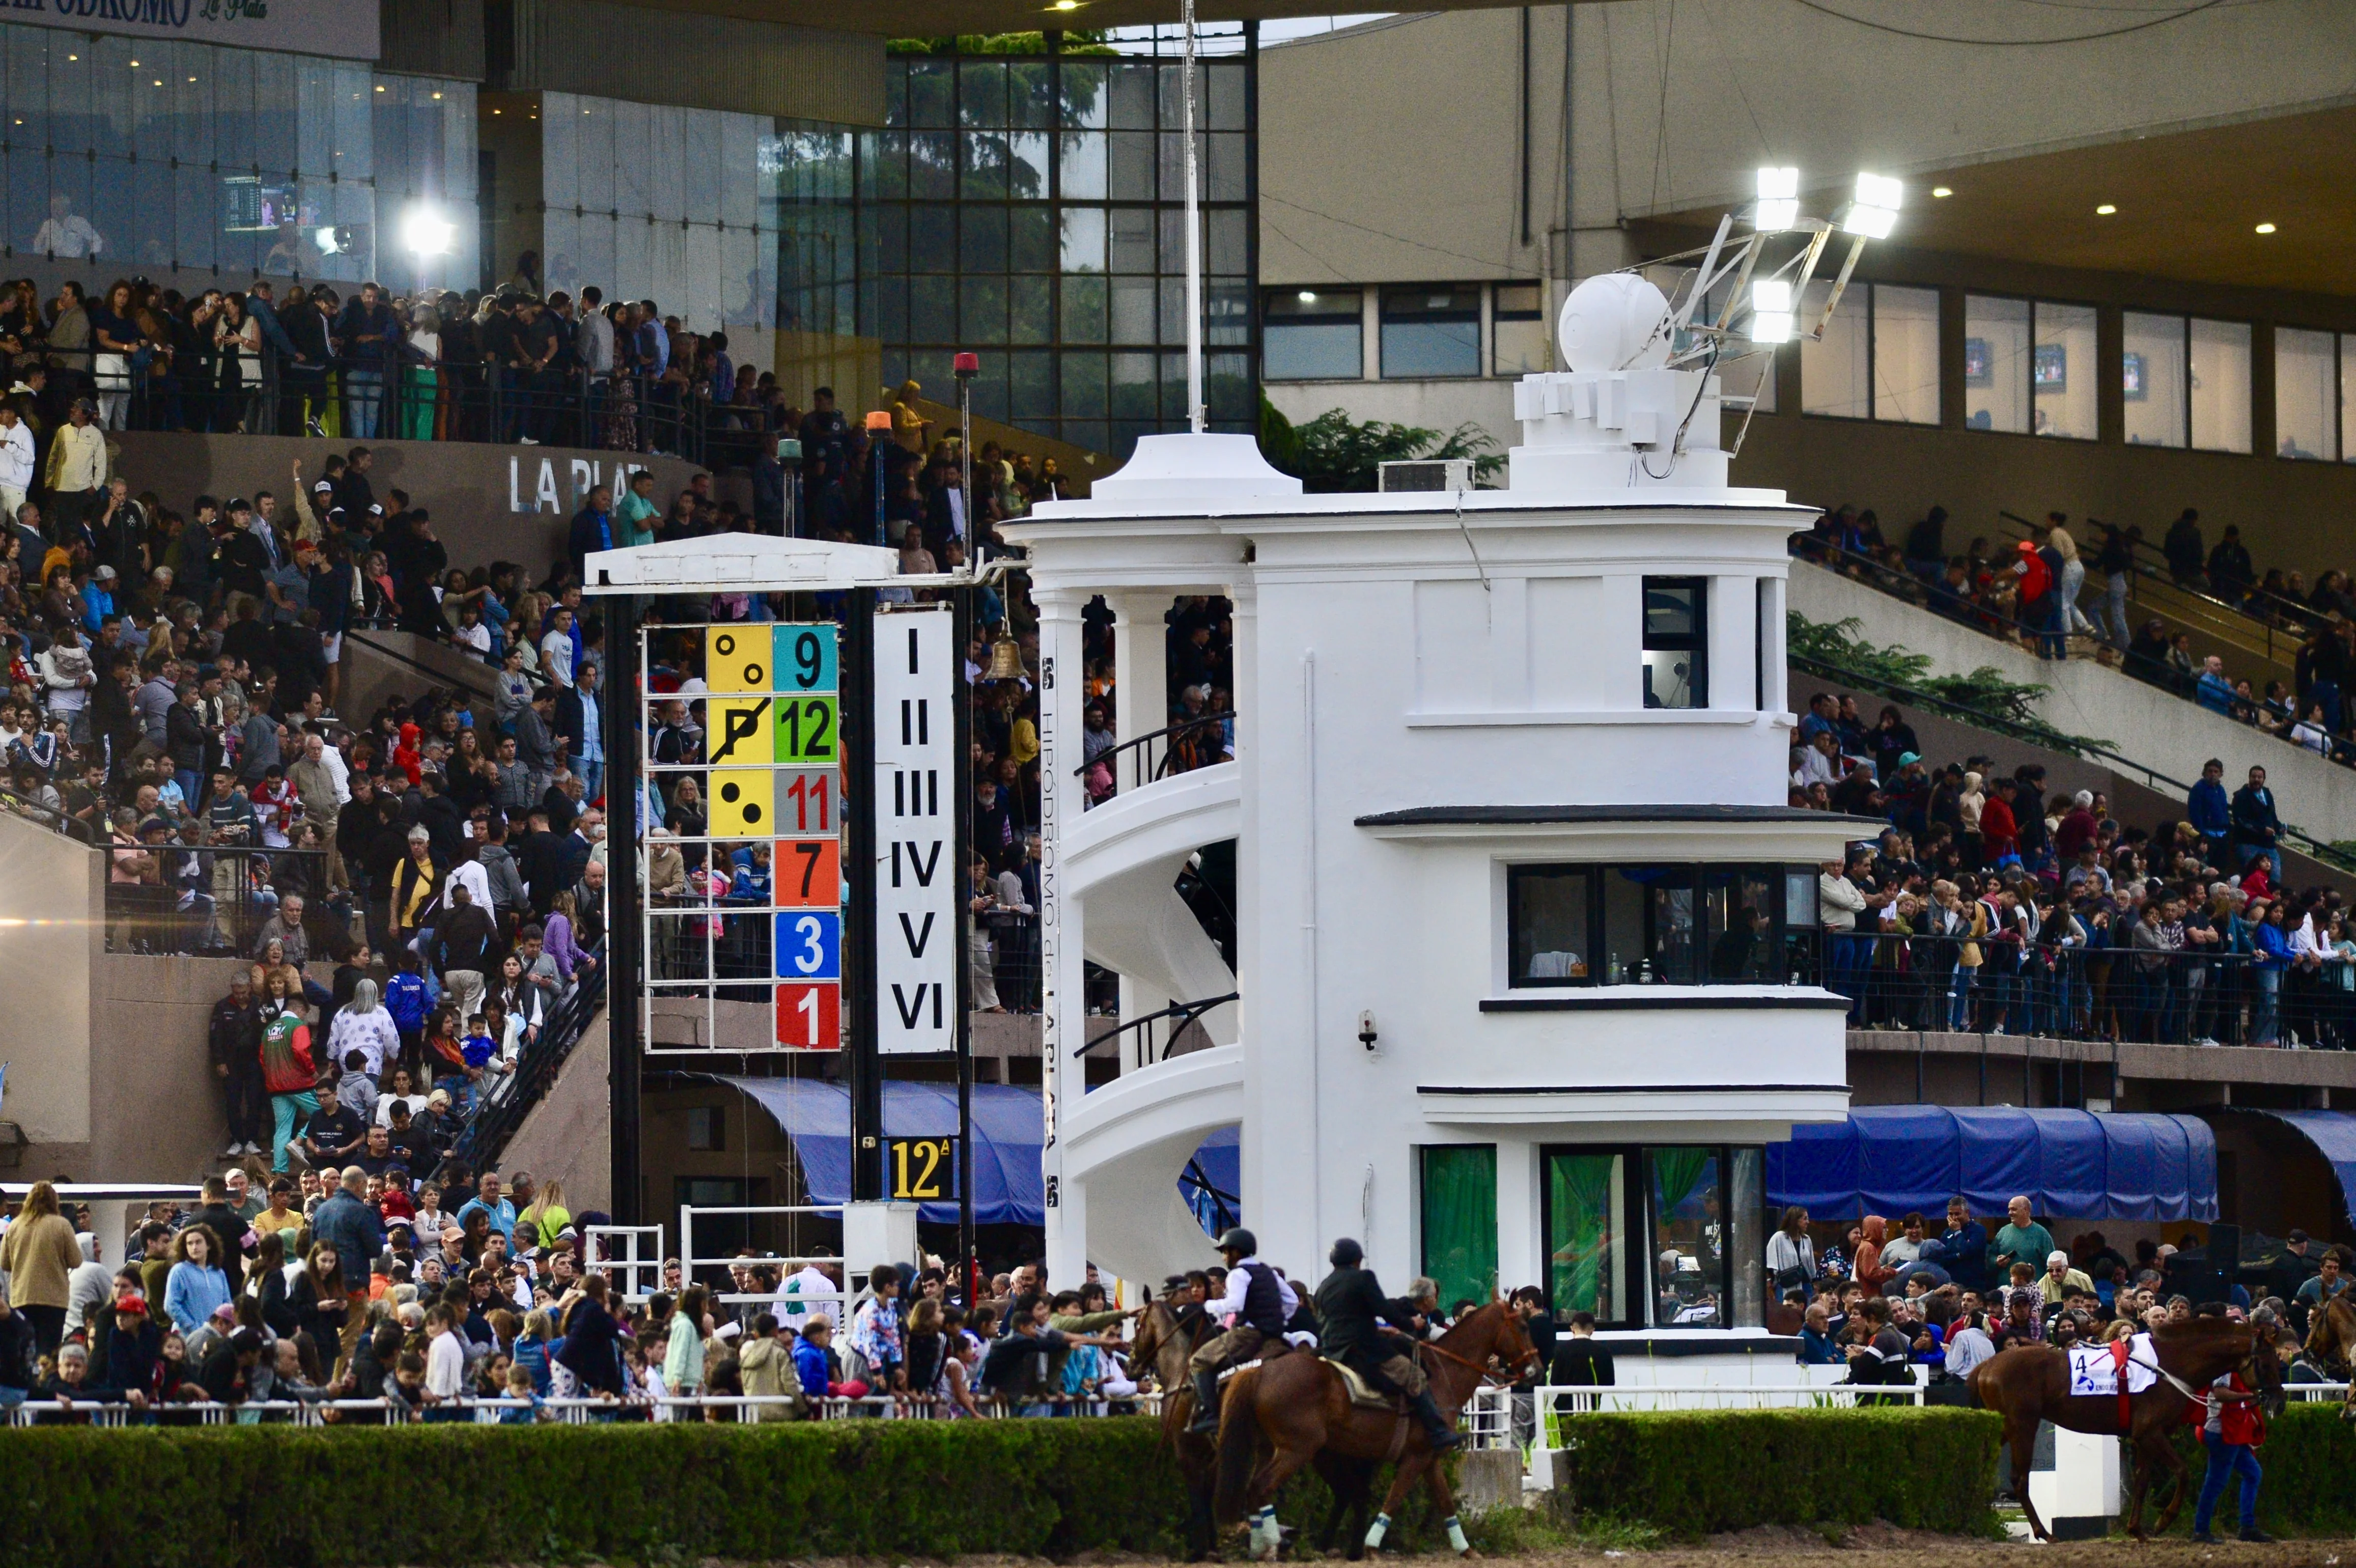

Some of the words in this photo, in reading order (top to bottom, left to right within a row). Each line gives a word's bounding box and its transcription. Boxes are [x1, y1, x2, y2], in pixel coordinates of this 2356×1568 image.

[511, 456, 560, 514] LA
[795, 632, 822, 688] 9
[781, 701, 831, 757] 12
[902, 699, 928, 745] II
[788, 774, 828, 830] 11
[894, 770, 937, 816] III
[796, 843, 822, 898] 7
[891, 841, 942, 887] IV
[795, 916, 824, 973] 3
[899, 912, 936, 958] V
[1044, 939, 1054, 977] de
[798, 988, 819, 1045] 1
[891, 983, 943, 1029] VI
[2075, 1355, 2087, 1374] 4
